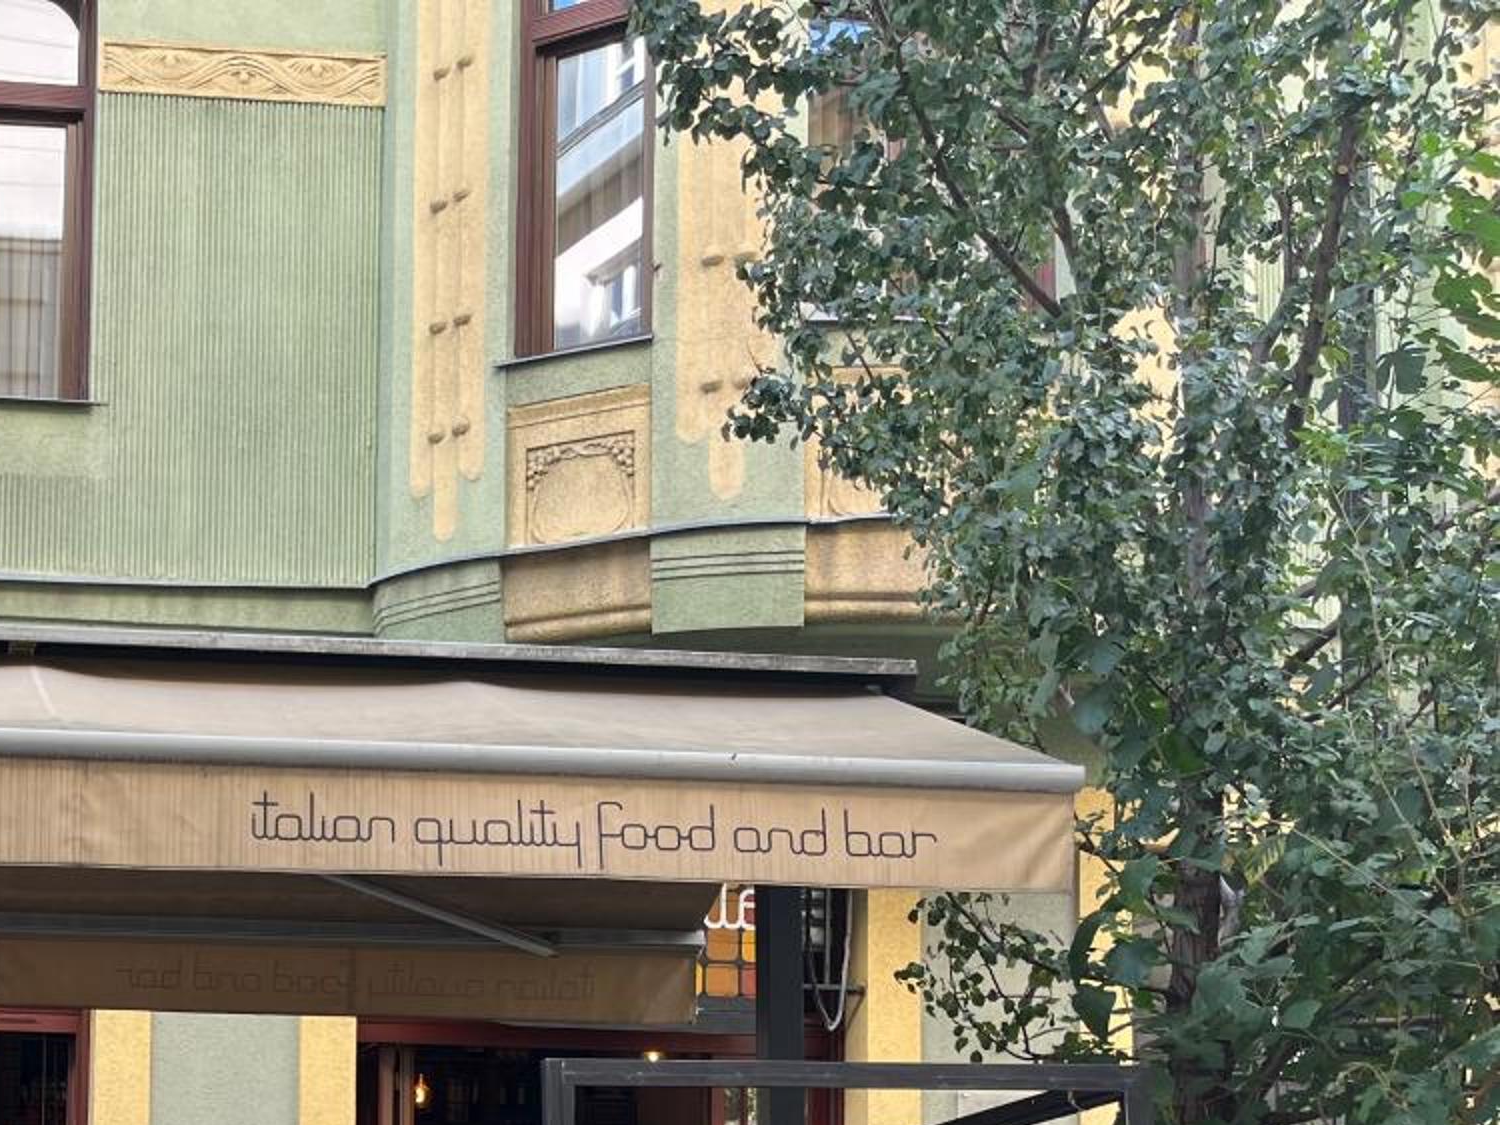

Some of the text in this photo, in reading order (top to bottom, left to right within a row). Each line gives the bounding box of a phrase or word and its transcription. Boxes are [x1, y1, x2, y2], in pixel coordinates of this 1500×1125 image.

[251, 790, 937, 870] italian quality food and bar
